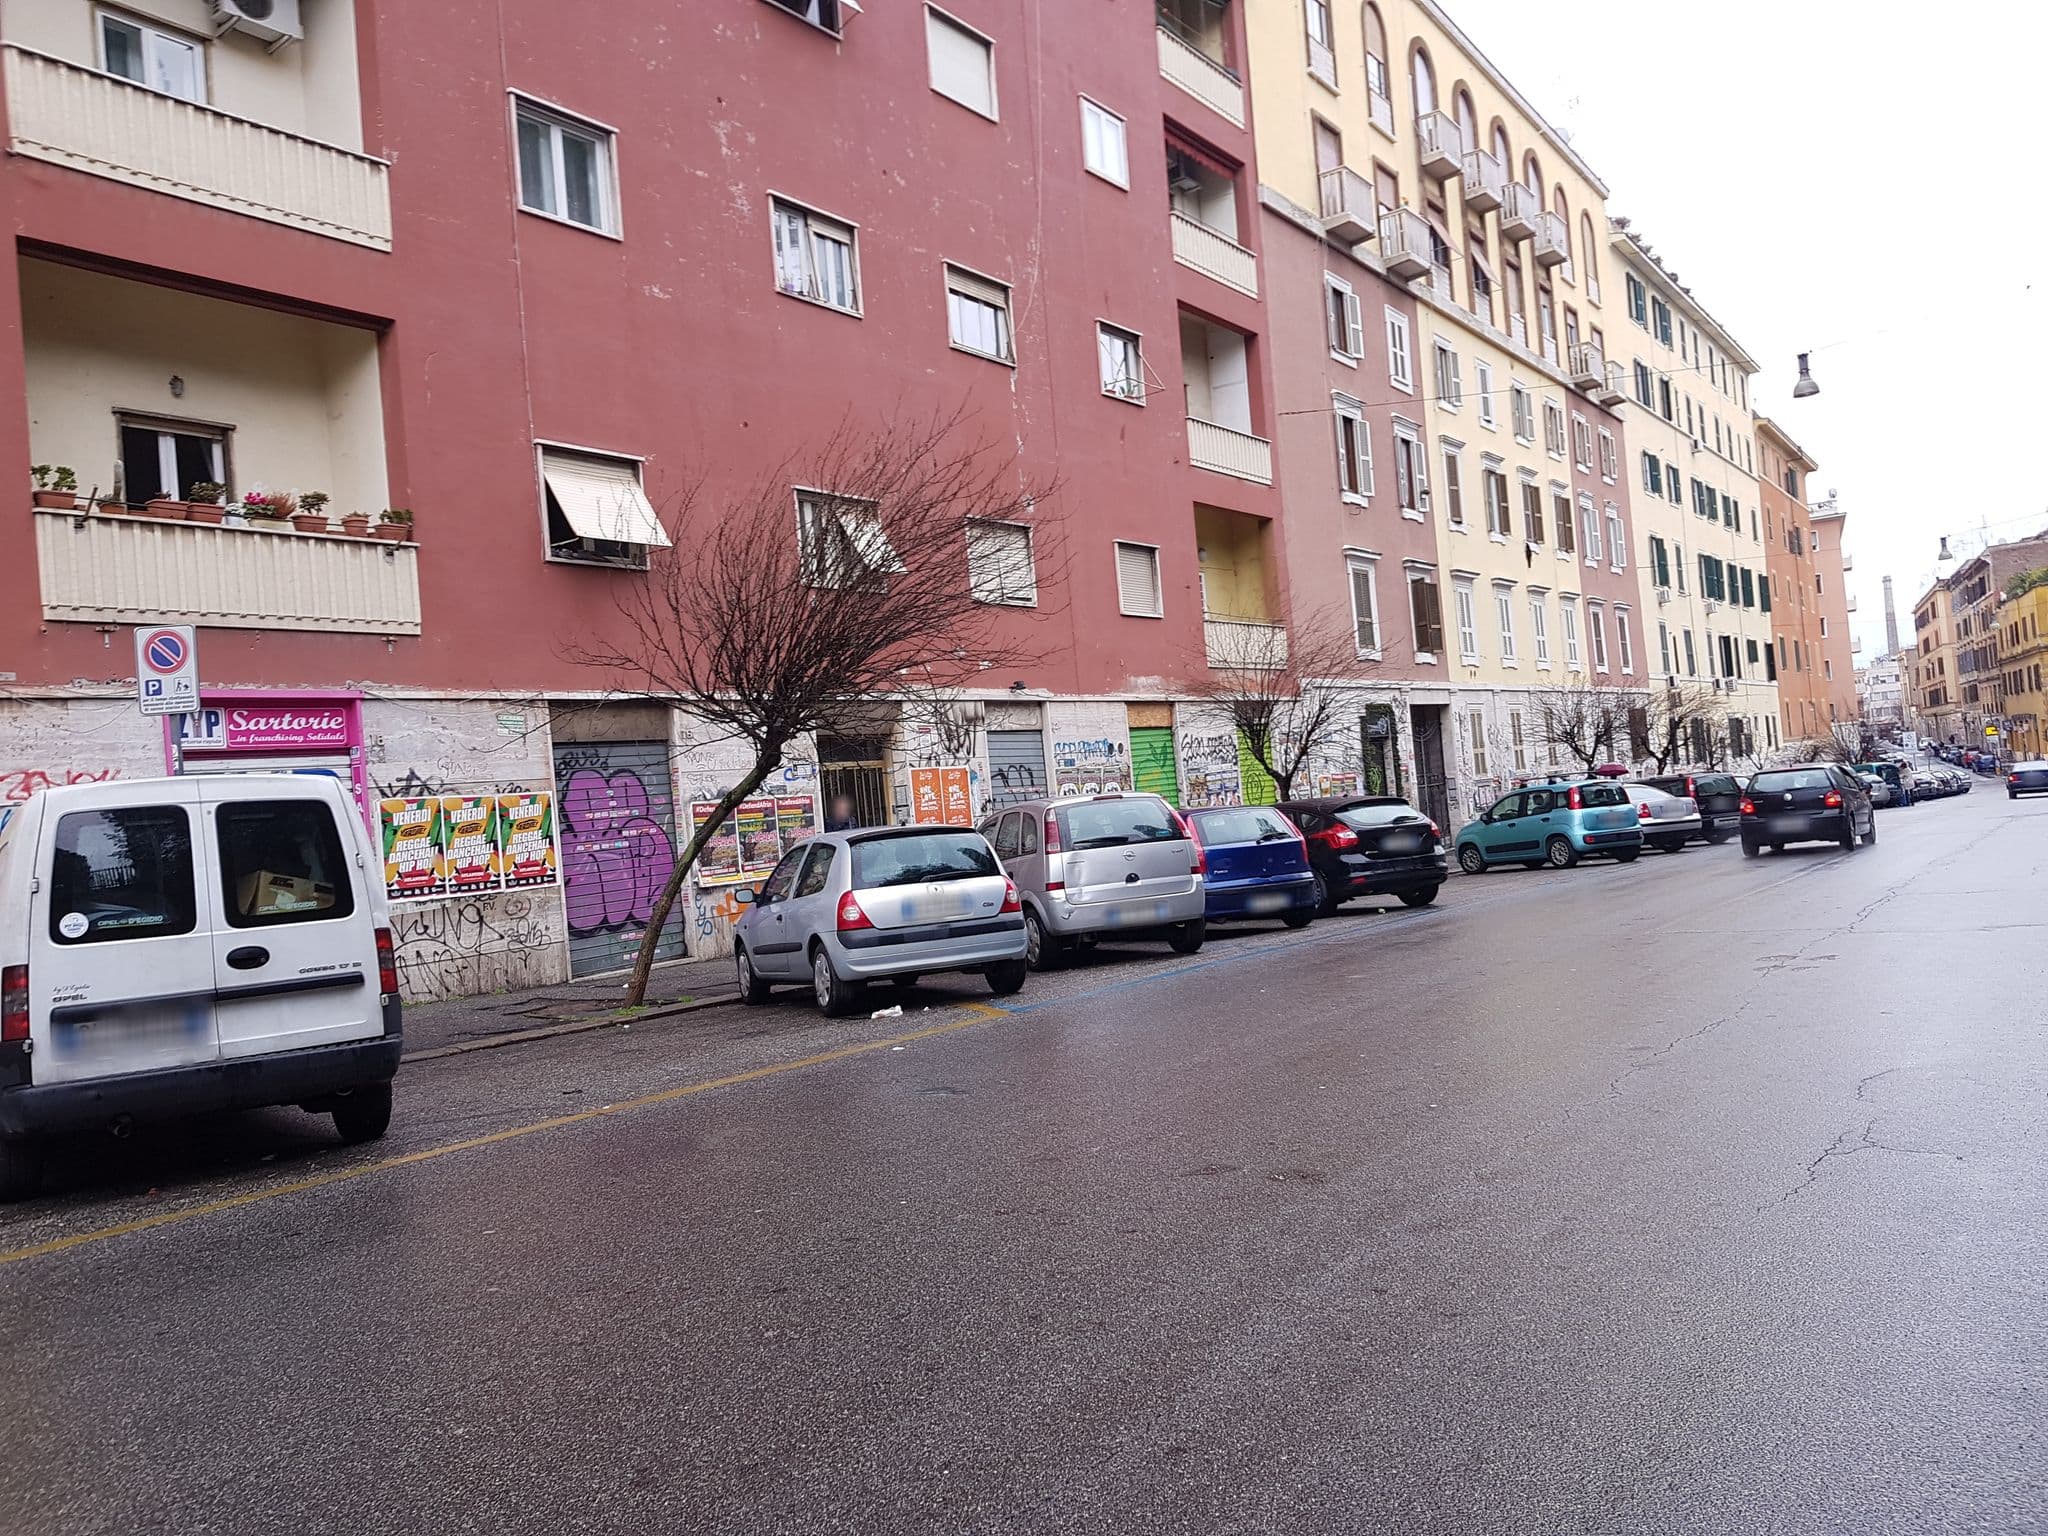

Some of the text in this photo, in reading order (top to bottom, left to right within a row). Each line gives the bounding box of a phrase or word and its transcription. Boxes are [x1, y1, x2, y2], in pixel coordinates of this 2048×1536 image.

[148, 681, 160, 695] P
[229, 710, 345, 731] Sartorie
[249, 733, 304, 744] franchising
[306, 732, 346, 741] Solidale
[392, 805, 432, 826] VENERDÌ
[451, 804, 487, 824] VENERDÌ
[509, 801, 543, 820] VENERDÌ
[396, 836, 432, 852] REGGAE
[454, 834, 487, 848] REGGAE
[512, 829, 543, 844] REGGAE
[447, 842, 494, 860] DANCEHALL
[506, 838, 550, 855] DANCEHALL
[389, 846, 439, 864] DANCEHALL
[456, 854, 490, 869] HIP HOP
[515, 848, 547, 864] HIP HOP
[399, 860, 415, 873] HIP
[52, 993, 88, 1003] OPEL
